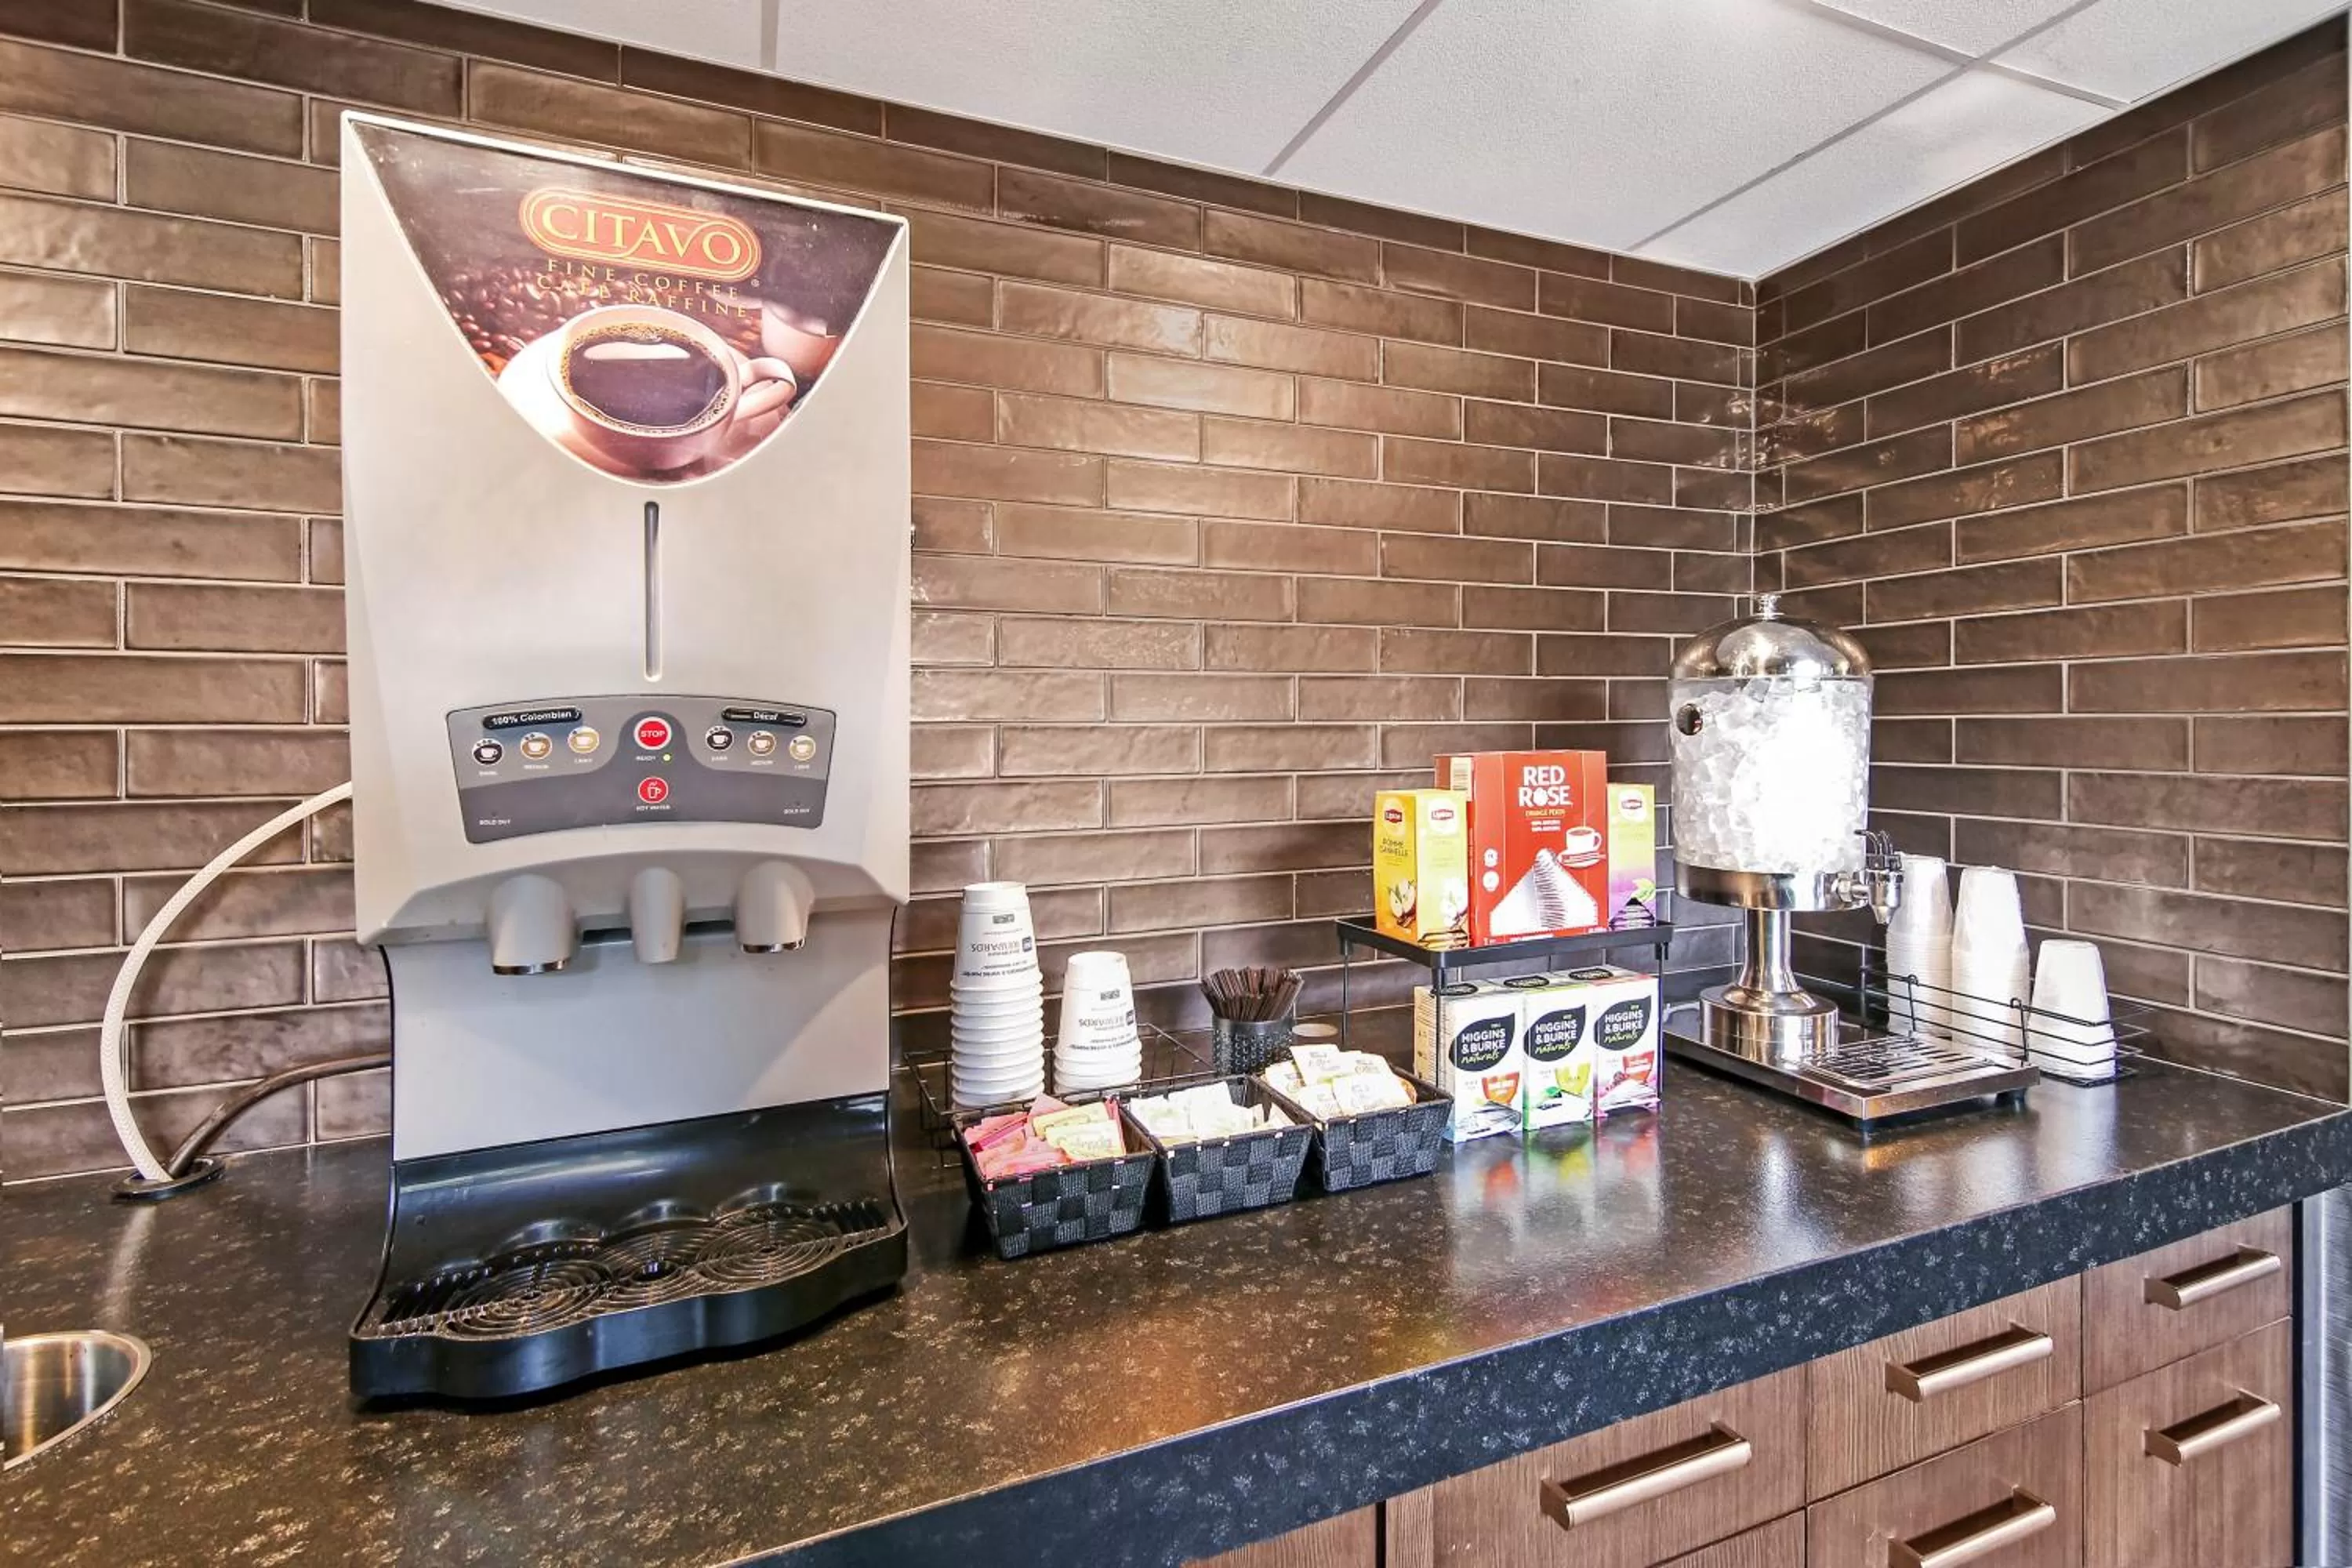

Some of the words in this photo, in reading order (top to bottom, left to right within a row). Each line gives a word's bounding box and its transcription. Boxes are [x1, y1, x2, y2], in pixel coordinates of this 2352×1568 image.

[541, 204, 742, 265] CITAVO
[548, 260, 615, 281] FINE
[634, 273, 739, 299] COFFEE
[520, 711, 572, 722] Colombian
[1523, 765, 1565, 786] RED
[1518, 785, 1570, 808] ROSE
[1605, 1009, 1644, 1023] HIGGINS
[1535, 1019, 1577, 1034] HIGGINS
[1461, 1028, 1506, 1044] HIGGINS
[1461, 1050, 1500, 1065] naturals
